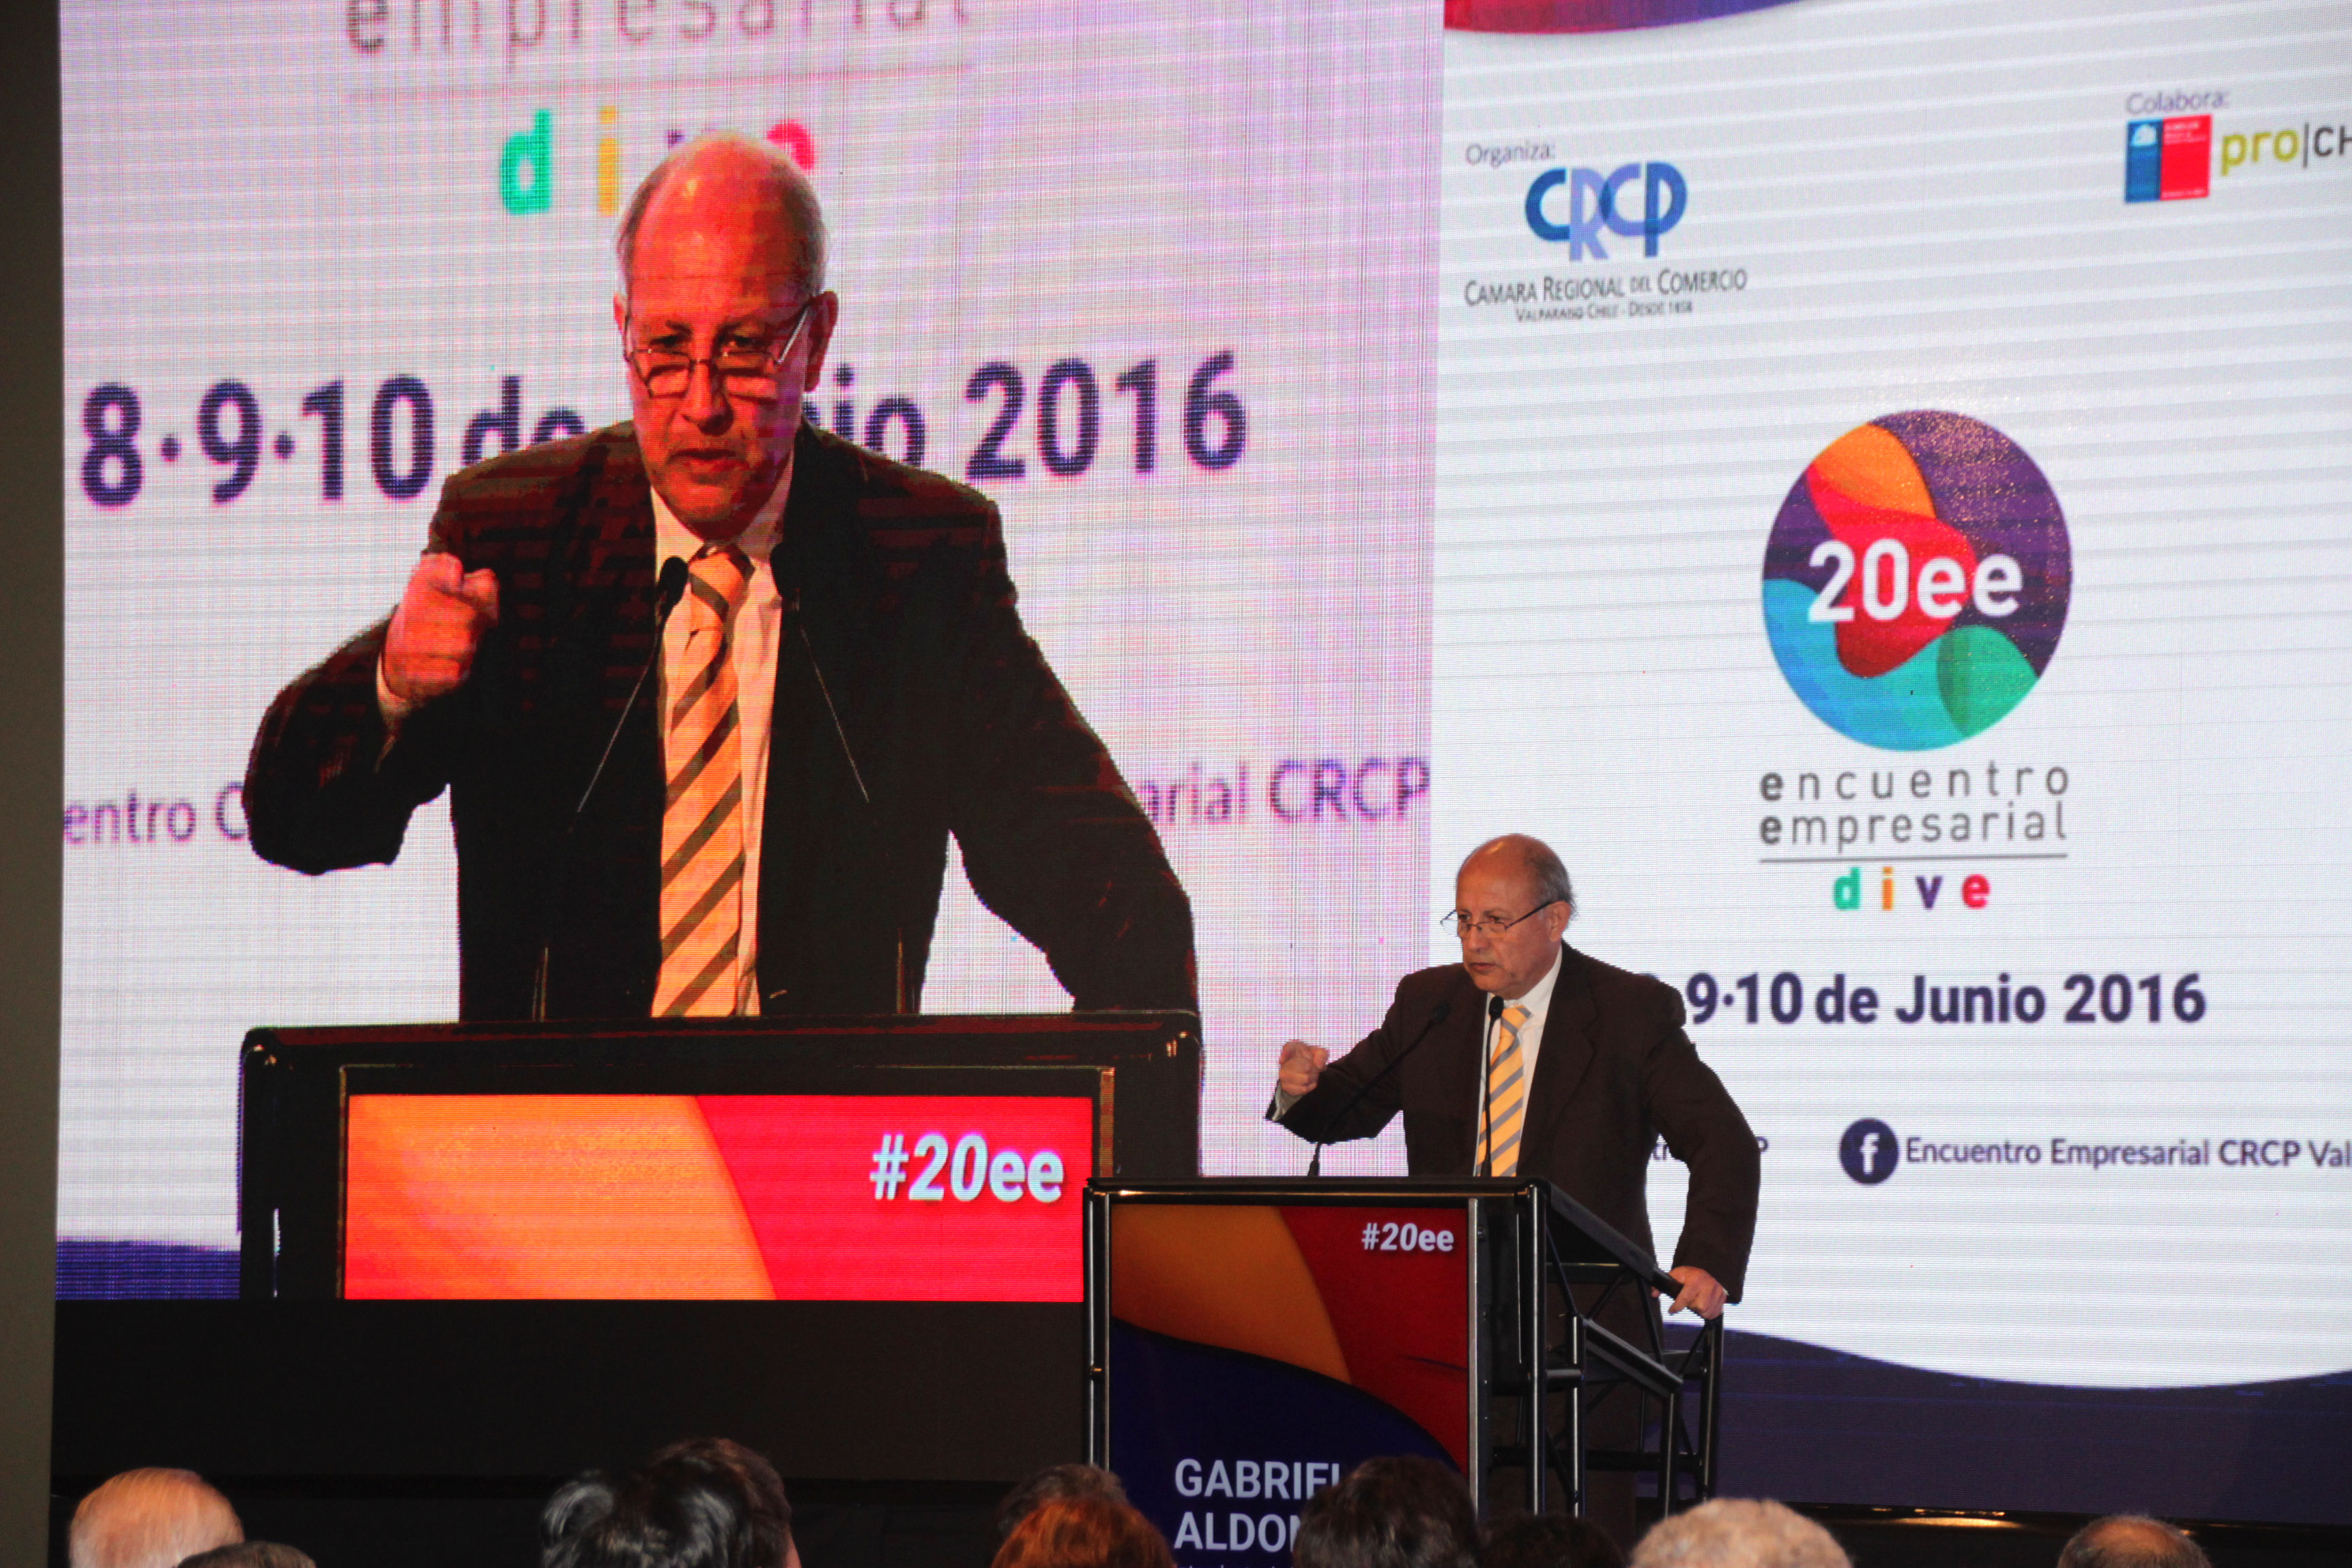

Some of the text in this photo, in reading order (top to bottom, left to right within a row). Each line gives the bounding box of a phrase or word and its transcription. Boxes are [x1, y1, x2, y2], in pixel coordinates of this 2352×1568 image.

[1524, 161, 1688, 261] CRCP
[1657, 268, 1748, 295] COMERCIO
[964, 350, 1247, 480] 2016
[1808, 537, 2023, 623] 20ee
[1269, 757, 1429, 822] CRCP
[1760, 760, 2069, 802] encuentro
[1760, 801, 2066, 853] empresarial
[1833, 866, 1991, 911] dive
[1815, 974, 1879, 1024] de
[1896, 973, 2046, 1025] Junio
[2063, 972, 2207, 1024] 2016
[870, 1131, 1065, 1203] #20ee
[1906, 1137, 2042, 1166] Encuentro
[2051, 1138, 2210, 1170] Empresarial
[2219, 1139, 2301, 1166] CRCP
[1361, 1222, 1455, 1252] #20ee
